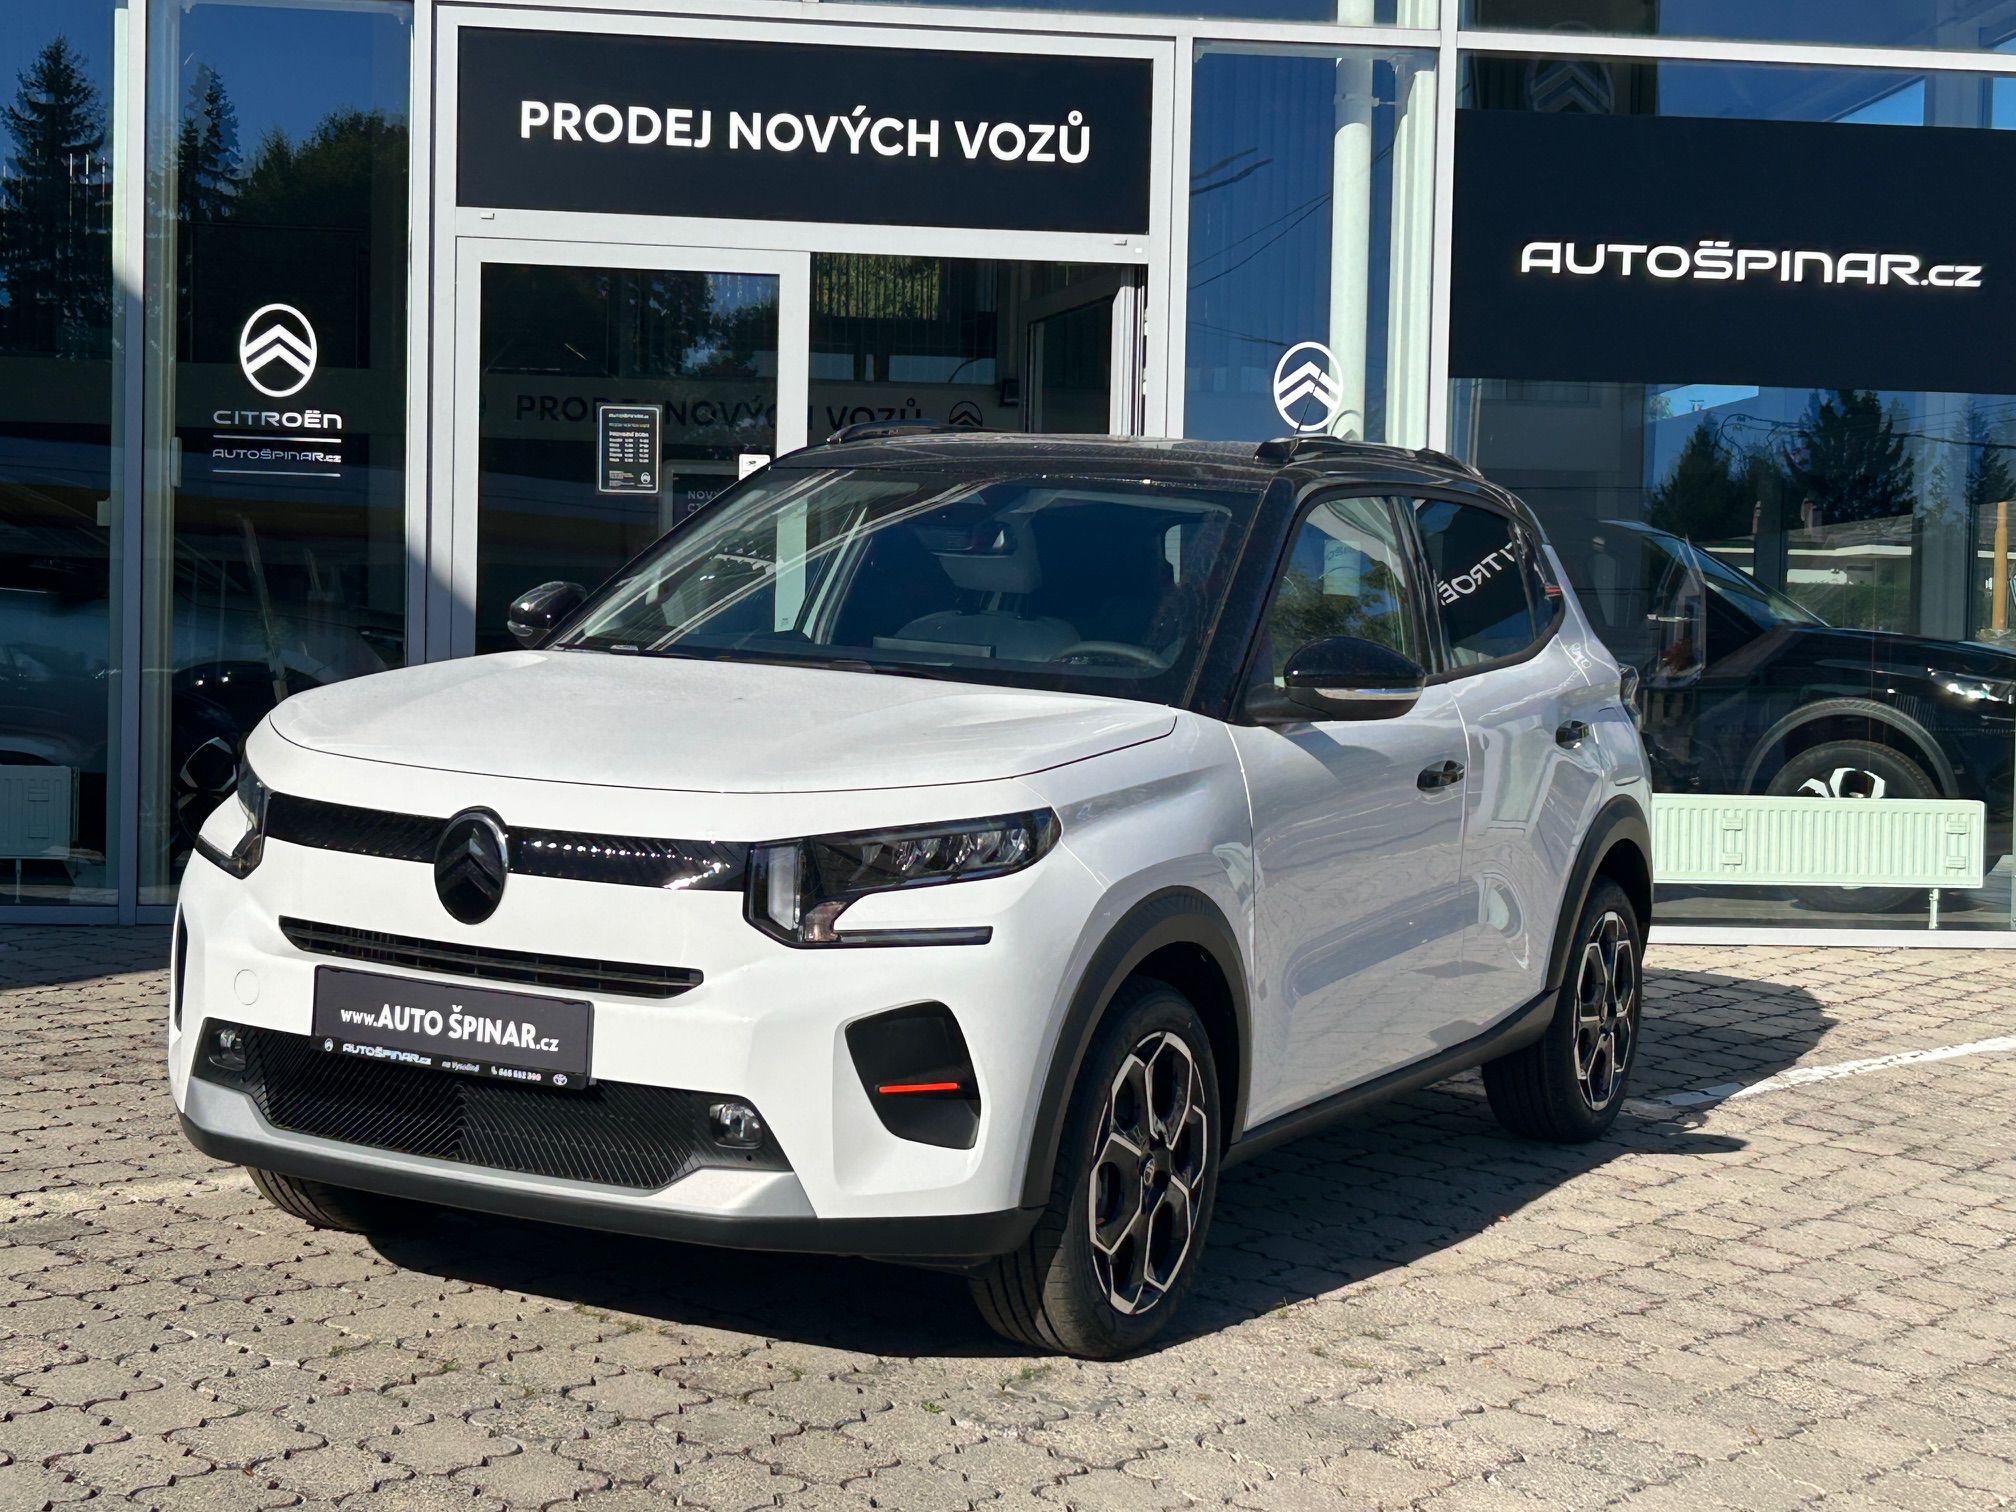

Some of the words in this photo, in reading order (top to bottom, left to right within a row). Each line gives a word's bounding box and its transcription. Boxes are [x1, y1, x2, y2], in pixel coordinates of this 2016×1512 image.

[520, 100, 712, 149] PRODEJ
[729, 105, 940, 158] NOVÝCH
[954, 110, 1090, 164] VOZŮ
[1520, 240, 1983, 288] AUTOŠPINAR.cz
[213, 409, 343, 430] CITROËN
[212, 448, 342, 464] AUTOŠPINAR.cz
[340, 1003, 444, 1037] www.AUTO
[447, 1004, 560, 1052] ŠPINAR.cz
